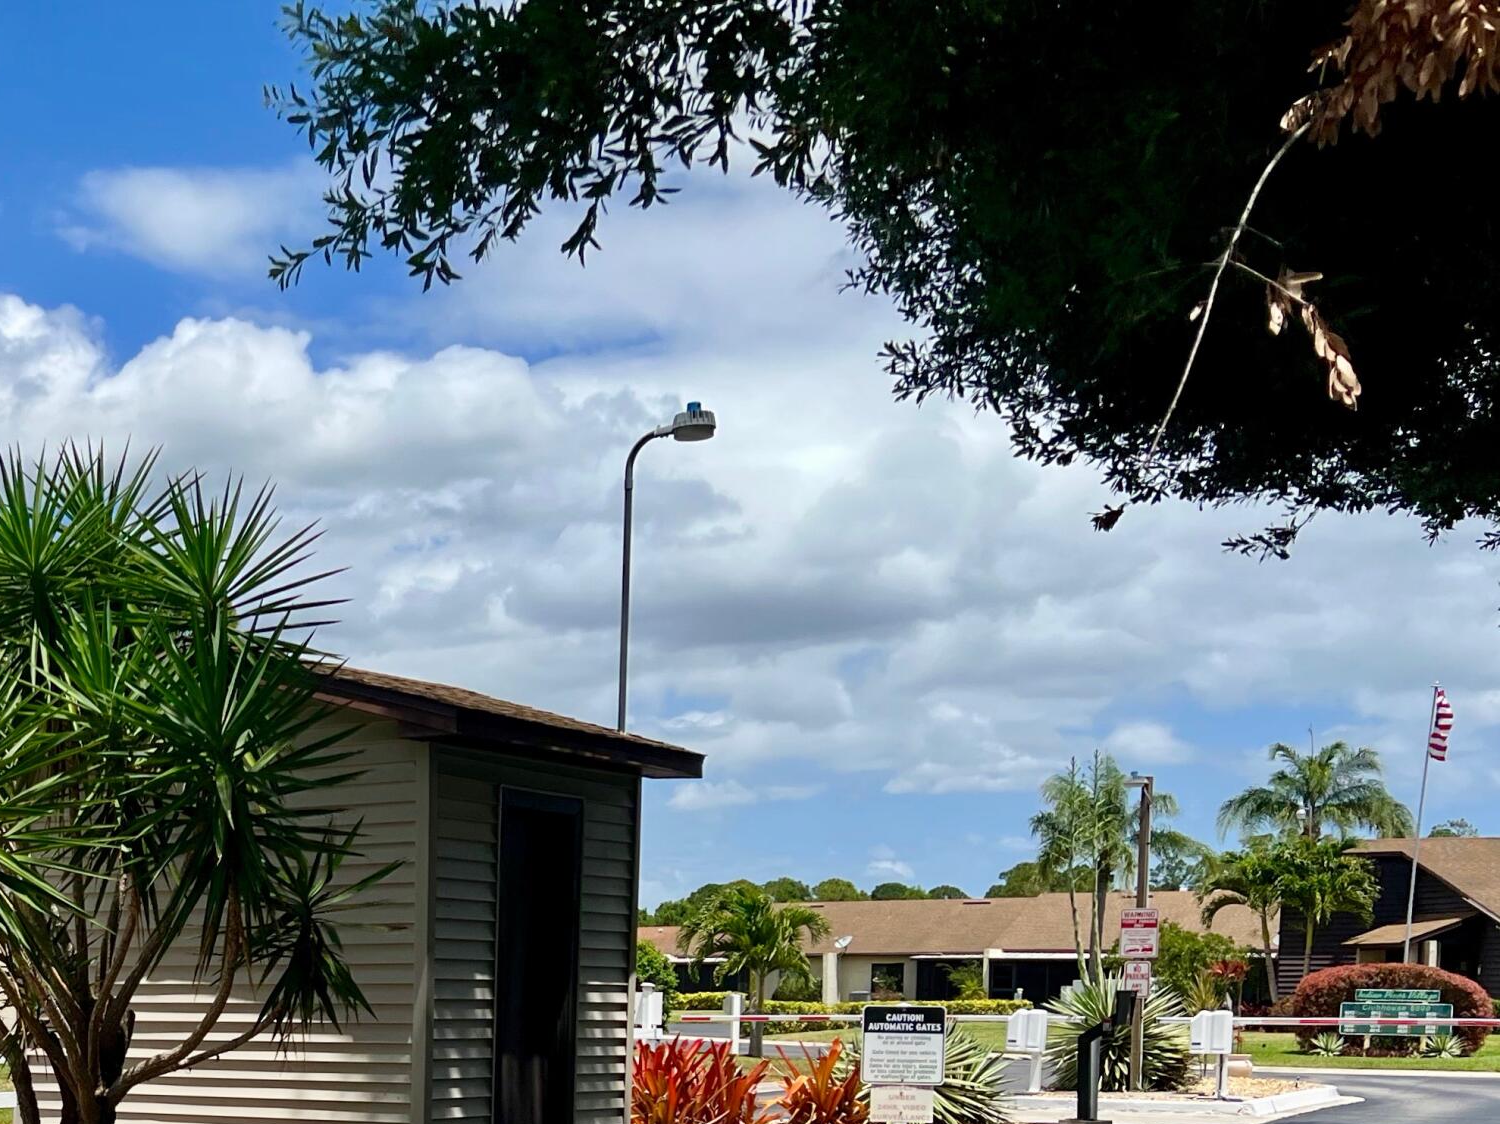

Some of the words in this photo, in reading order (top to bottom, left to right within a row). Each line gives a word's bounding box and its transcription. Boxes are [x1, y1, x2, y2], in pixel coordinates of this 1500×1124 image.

[886, 1014, 924, 1022] CAUTION!
[868, 1023, 914, 1031] AUTOMATIC
[916, 1023, 941, 1031] GATES
